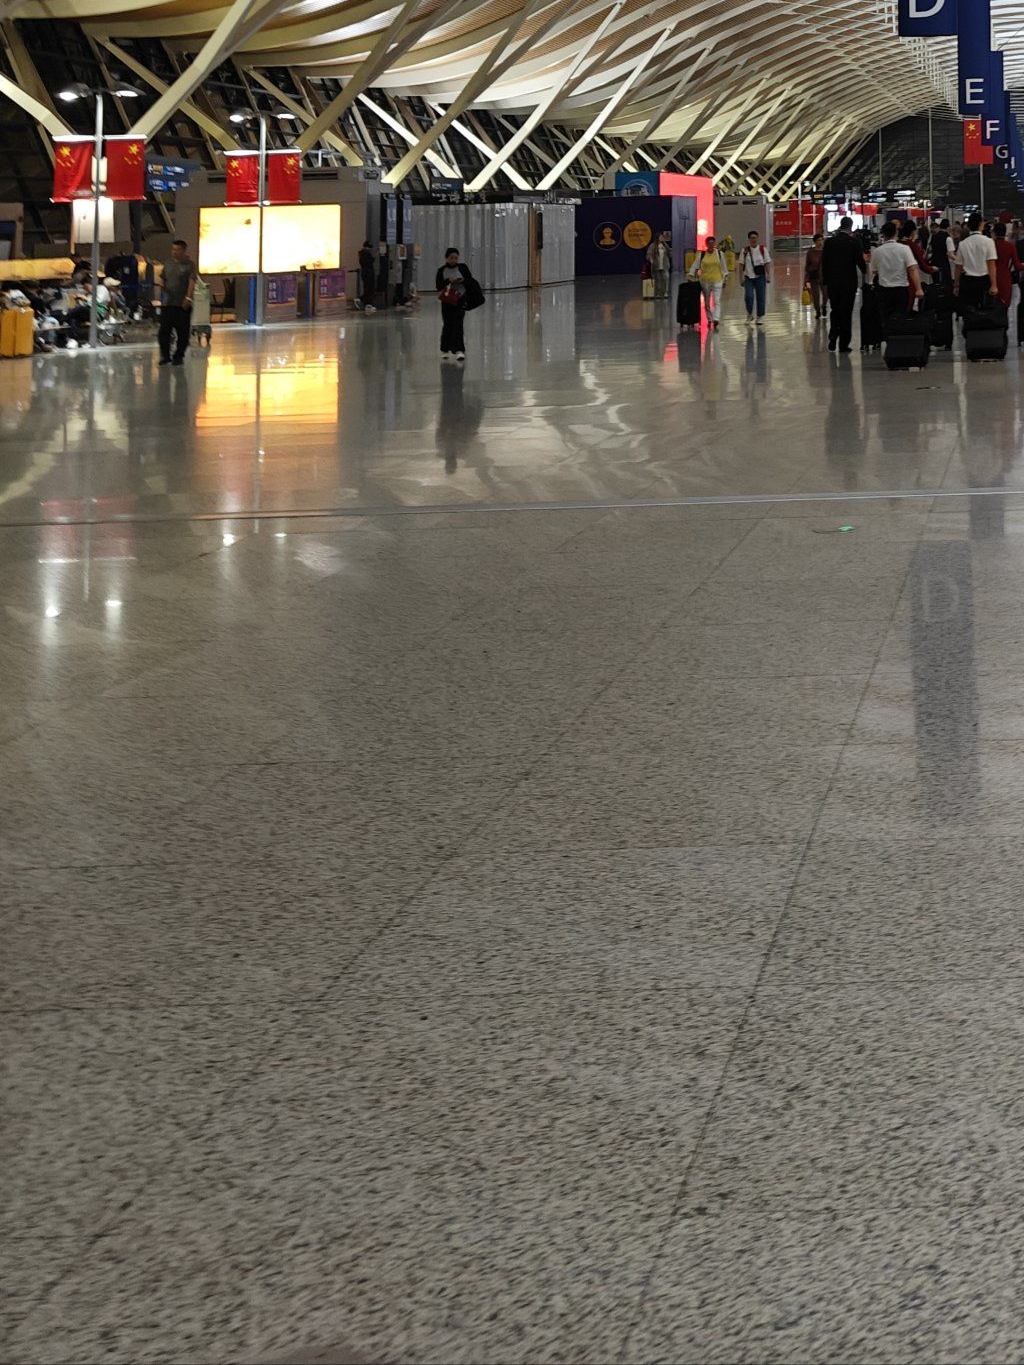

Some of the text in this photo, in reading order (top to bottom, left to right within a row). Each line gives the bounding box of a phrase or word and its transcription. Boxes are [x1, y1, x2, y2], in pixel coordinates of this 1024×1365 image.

[965, 78, 985, 104] E
[986, 119, 1000, 140] F
[995, 143, 1009, 159] G
